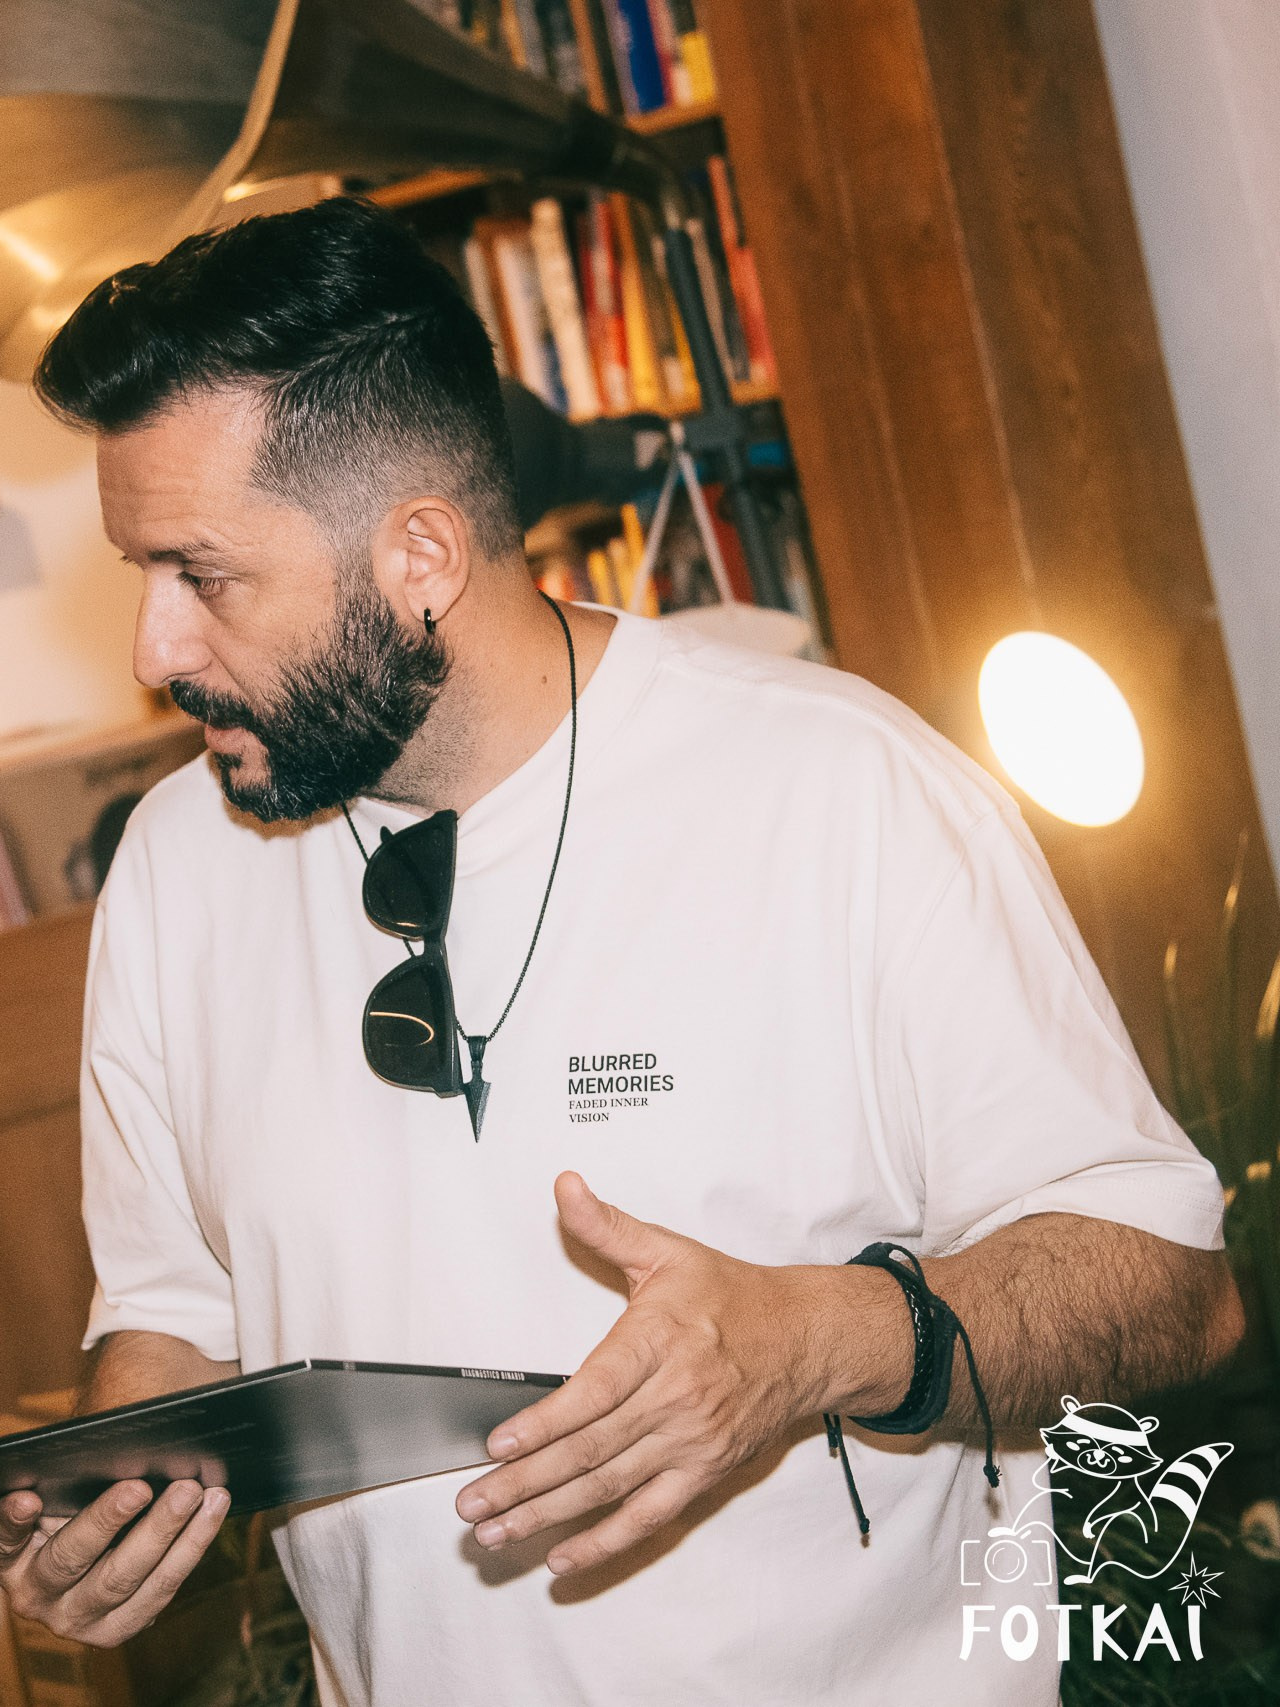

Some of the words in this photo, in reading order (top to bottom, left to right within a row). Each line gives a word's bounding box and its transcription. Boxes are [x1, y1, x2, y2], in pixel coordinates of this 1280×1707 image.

[568, 1053, 657, 1072] BLURRED
[568, 1075, 674, 1095] MEMORIES
[569, 1099, 608, 1109] FADED
[610, 1097, 648, 1107] INNER
[568, 1112, 610, 1123] VISION
